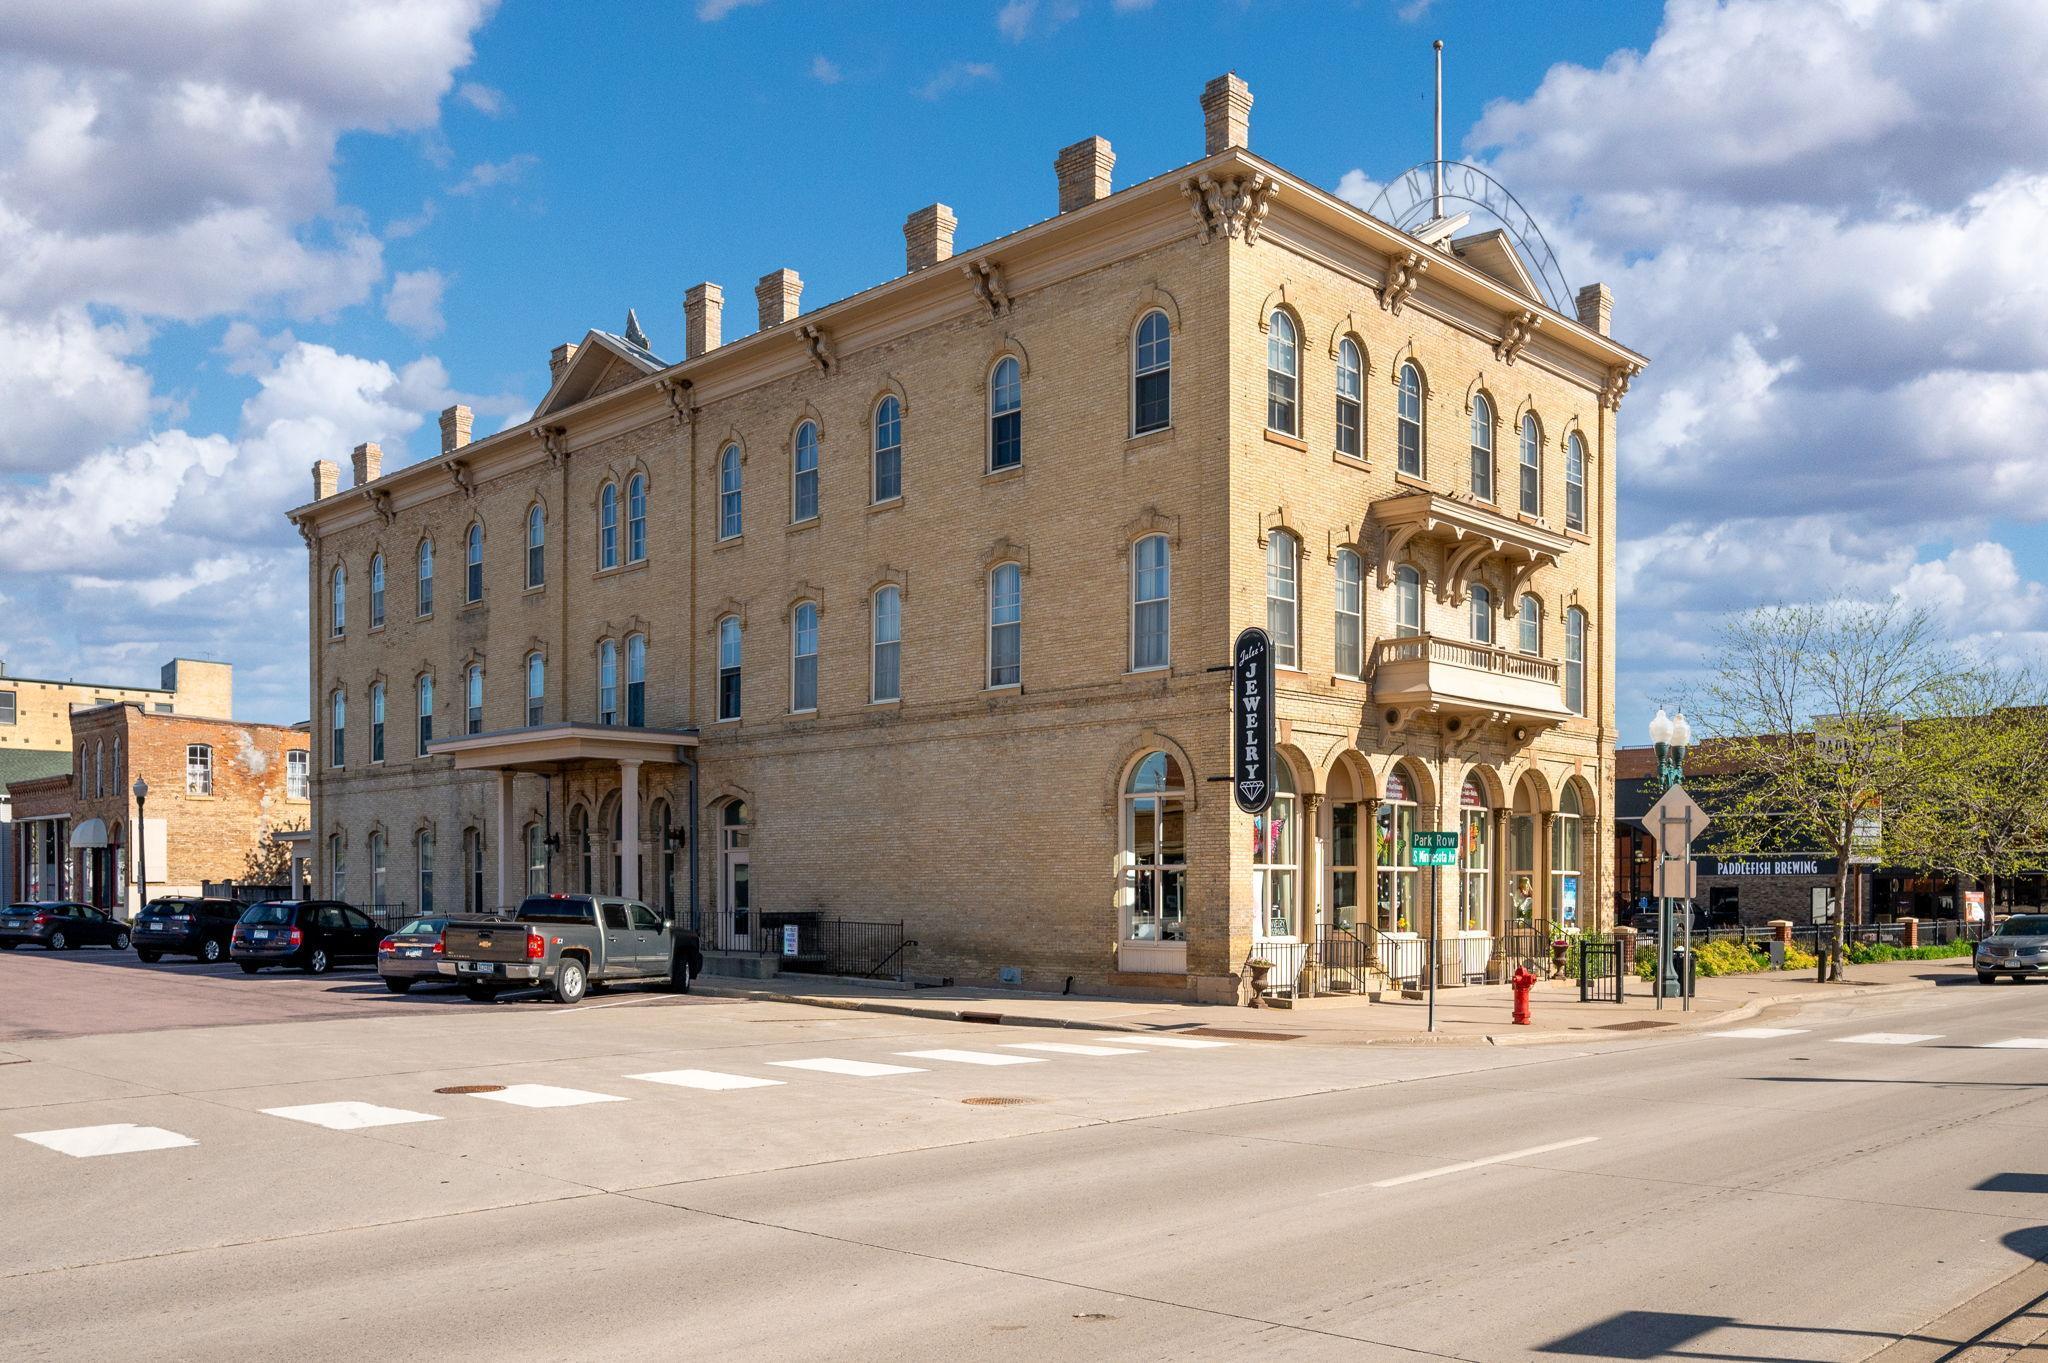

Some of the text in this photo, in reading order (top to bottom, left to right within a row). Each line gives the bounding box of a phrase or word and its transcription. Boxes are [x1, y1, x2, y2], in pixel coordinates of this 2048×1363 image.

[1404, 162, 1554, 270] NICOLLET
[1242, 663, 1261, 779] JEWELRY
[1414, 834, 1455, 847] Park Row
[1413, 850, 1418, 863] S
[1717, 861, 1818, 875] PADDLEFISH BREWING
